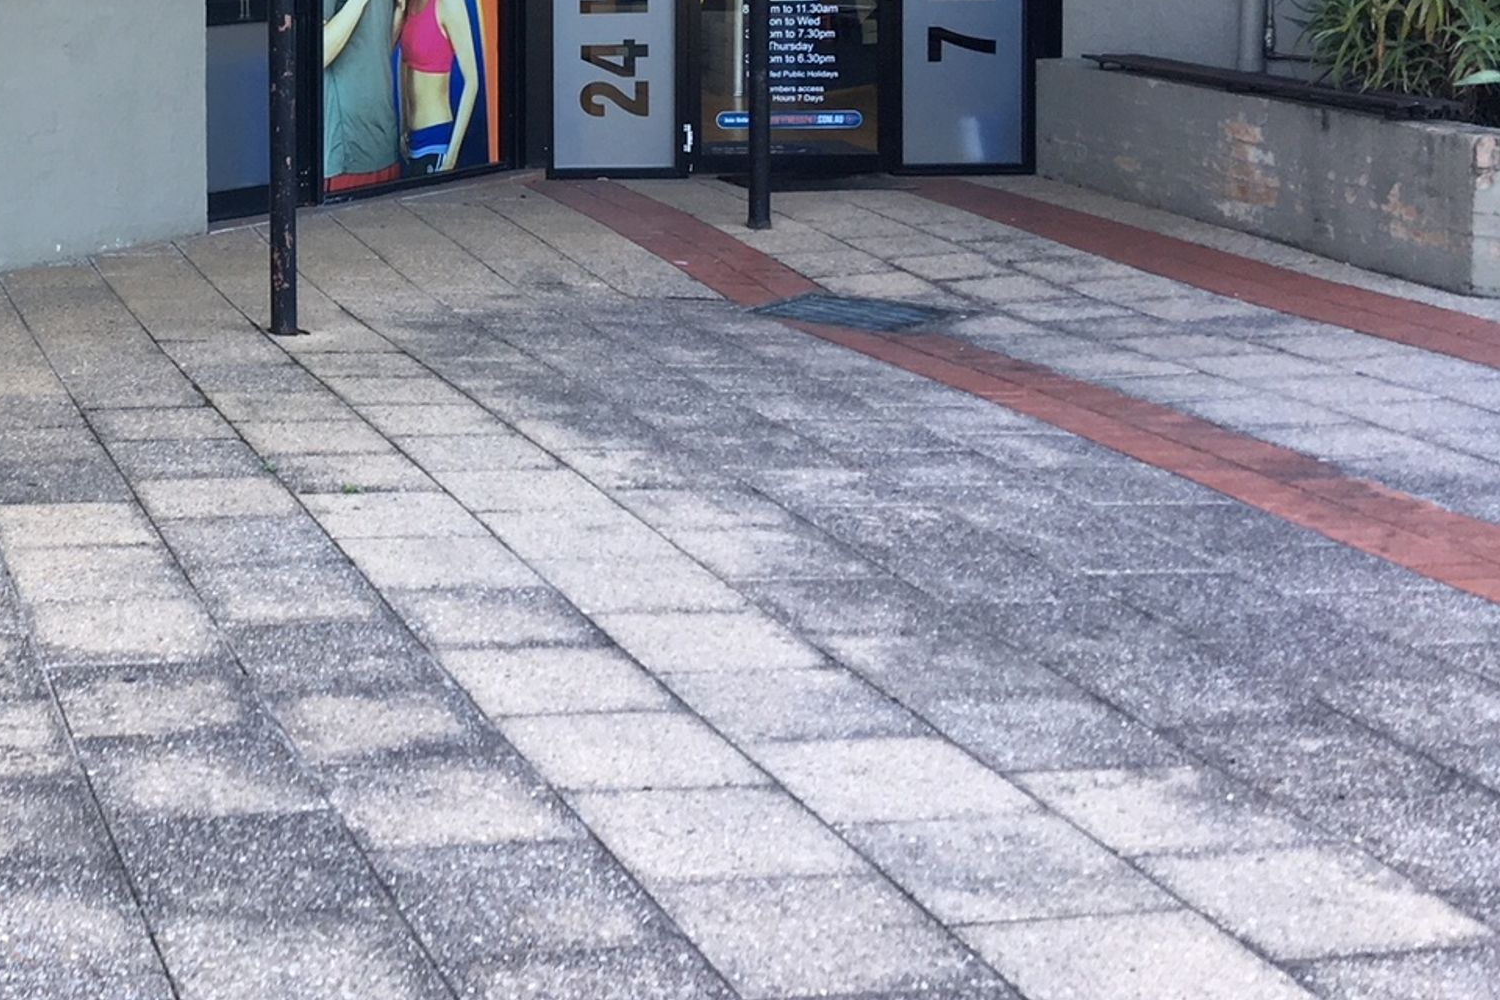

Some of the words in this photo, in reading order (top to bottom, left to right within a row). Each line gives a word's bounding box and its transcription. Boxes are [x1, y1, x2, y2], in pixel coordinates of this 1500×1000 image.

[782, 3, 793, 14] to
[796, 3, 839, 14] 11.30am
[784, 17, 795, 26] to
[796, 16, 821, 26] Wed
[785, 29, 796, 38] to
[797, 28, 836, 41] 7.30pm
[927, 26, 997, 62] 7
[785, 54, 796, 63] to
[797, 53, 836, 65] 6.30pm
[579, 39, 650, 118] 24
[782, 69, 805, 78] Public
[806, 69, 839, 79] Holidays
[772, 94, 796, 102] Hours
[803, 94, 824, 103] Days
